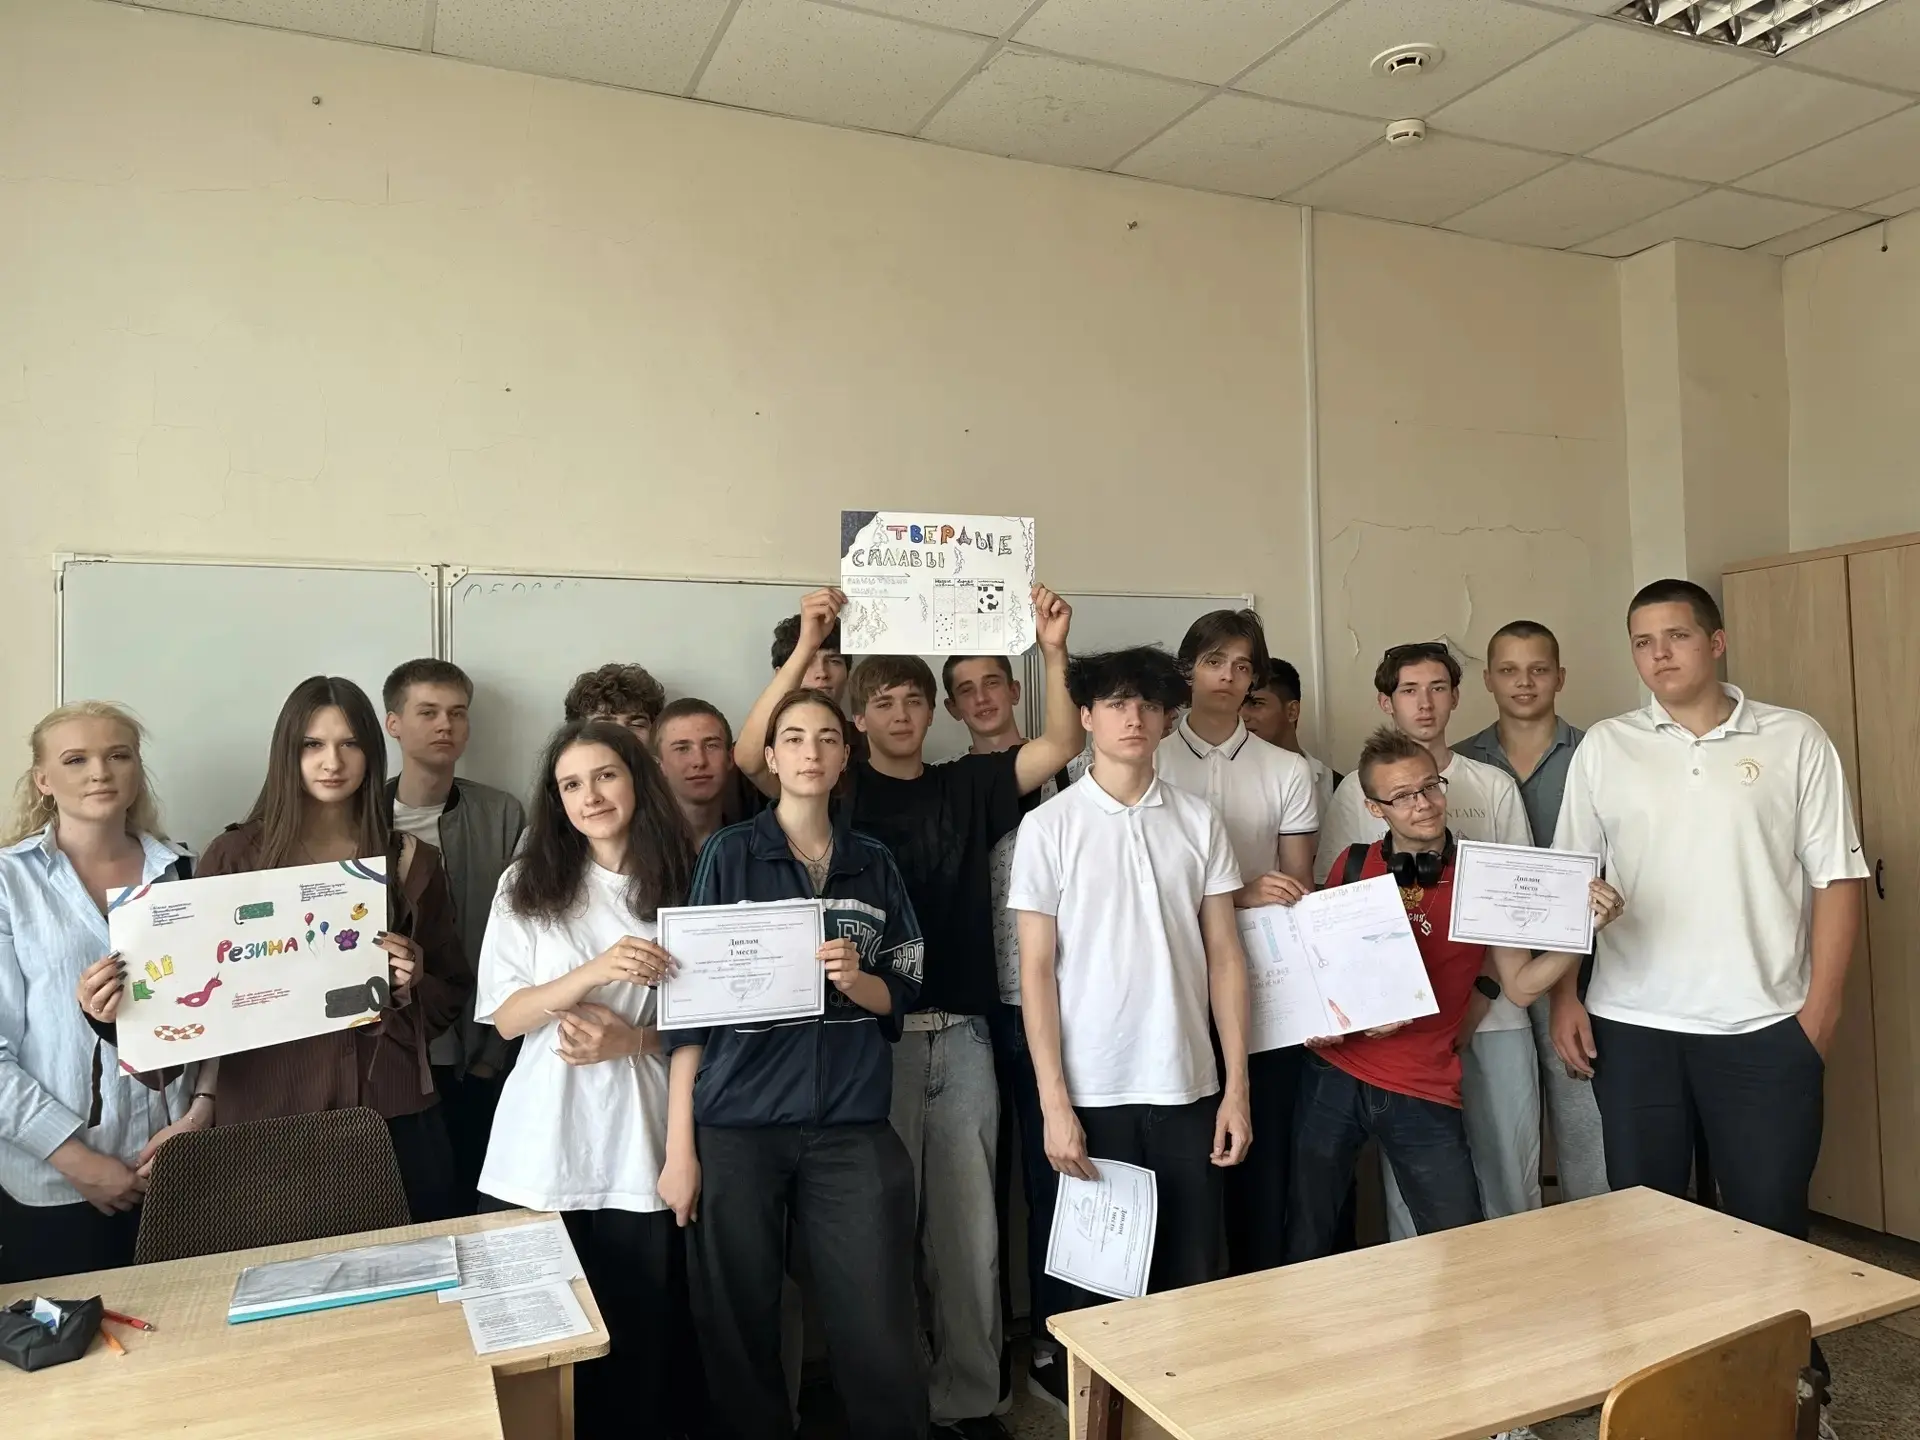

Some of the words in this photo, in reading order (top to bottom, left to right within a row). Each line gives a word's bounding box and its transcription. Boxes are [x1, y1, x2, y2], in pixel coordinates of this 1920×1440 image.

[887, 525, 1012, 556] ТВЕРДЫЕ
[852, 548, 945, 568] СПЛАВЫ
[1447, 807, 1486, 818] NTAINS
[1514, 875, 1540, 884] Диплом
[1408, 913, 1424, 922] СИЯ
[728, 938, 759, 947] Диплом
[735, 948, 758, 956] место
